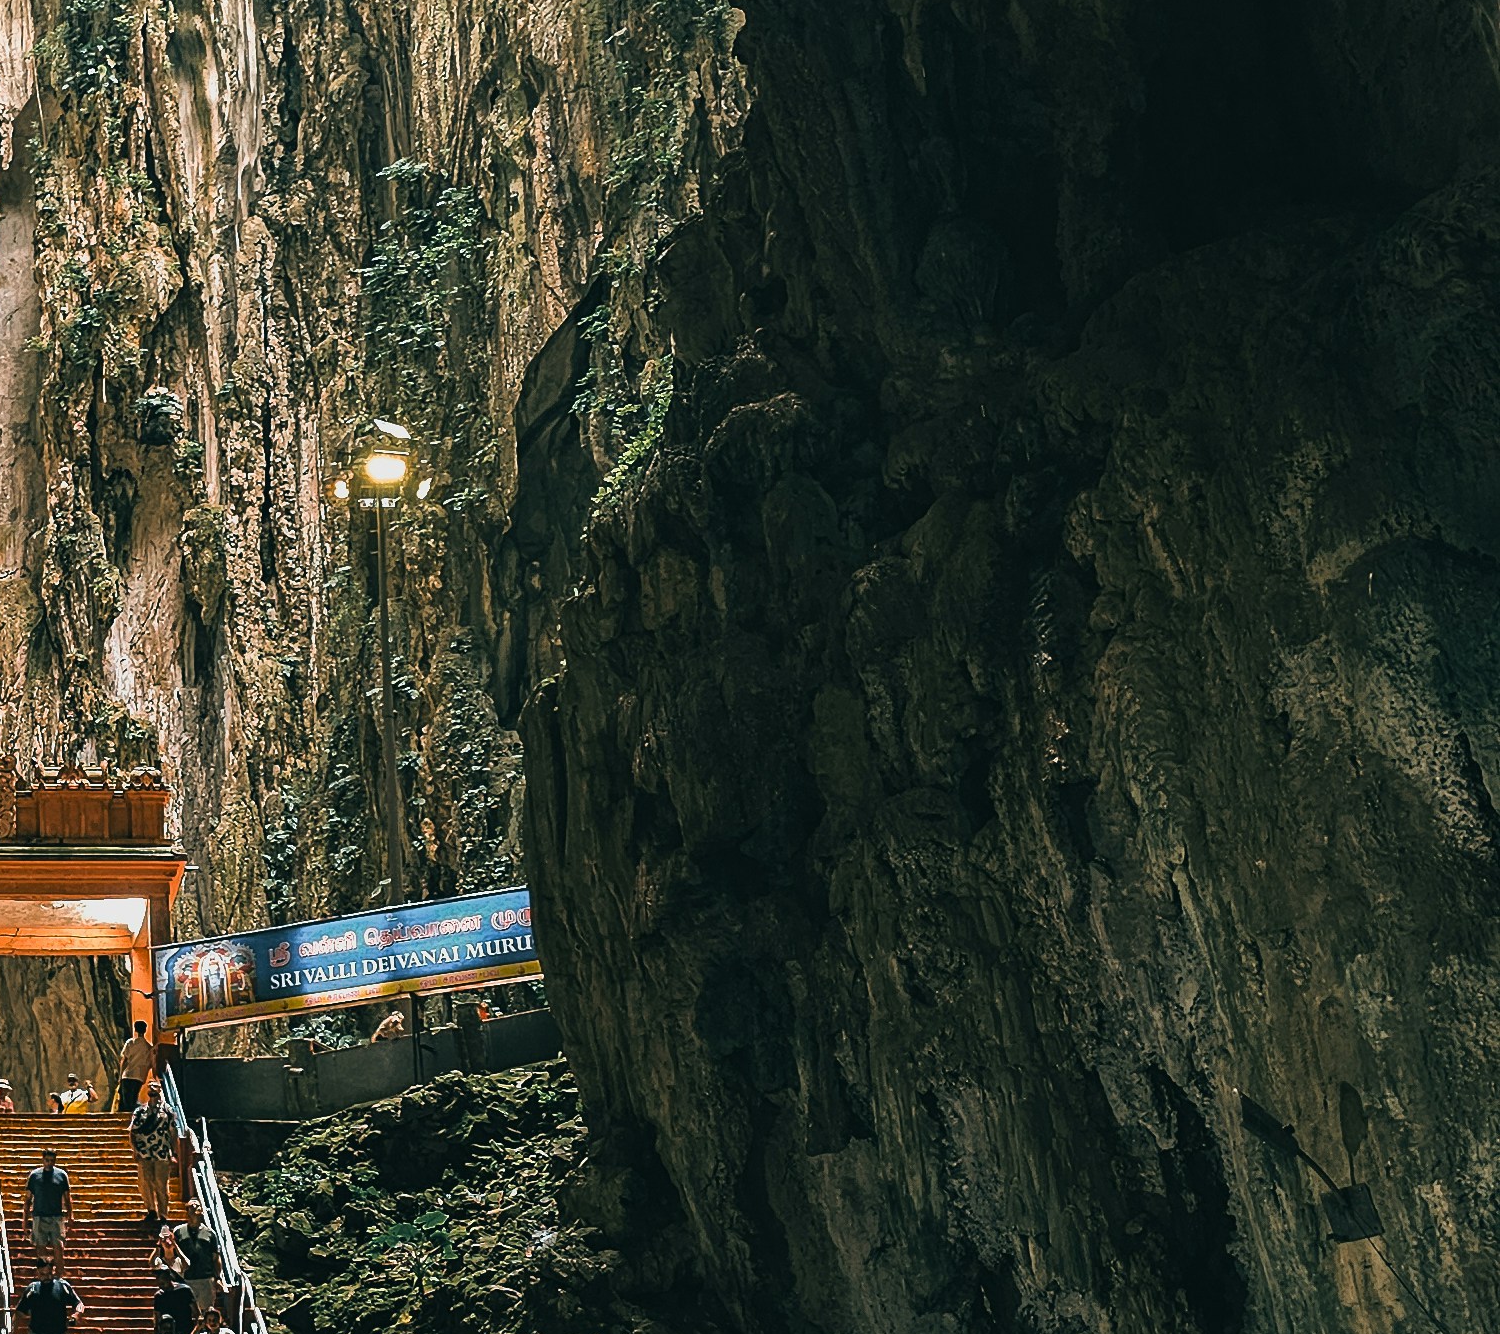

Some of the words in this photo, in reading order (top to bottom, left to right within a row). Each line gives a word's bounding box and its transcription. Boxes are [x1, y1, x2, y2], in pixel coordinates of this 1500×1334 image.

[299, 930, 357, 958] வள்ளி
[364, 914, 483, 951] தெய்வானை
[491, 906, 532, 931] முரு
[270, 970, 301, 990] SRI
[300, 961, 358, 985] VALLI
[362, 945, 460, 976] DEIVANAI
[465, 934, 534, 960] MURU
